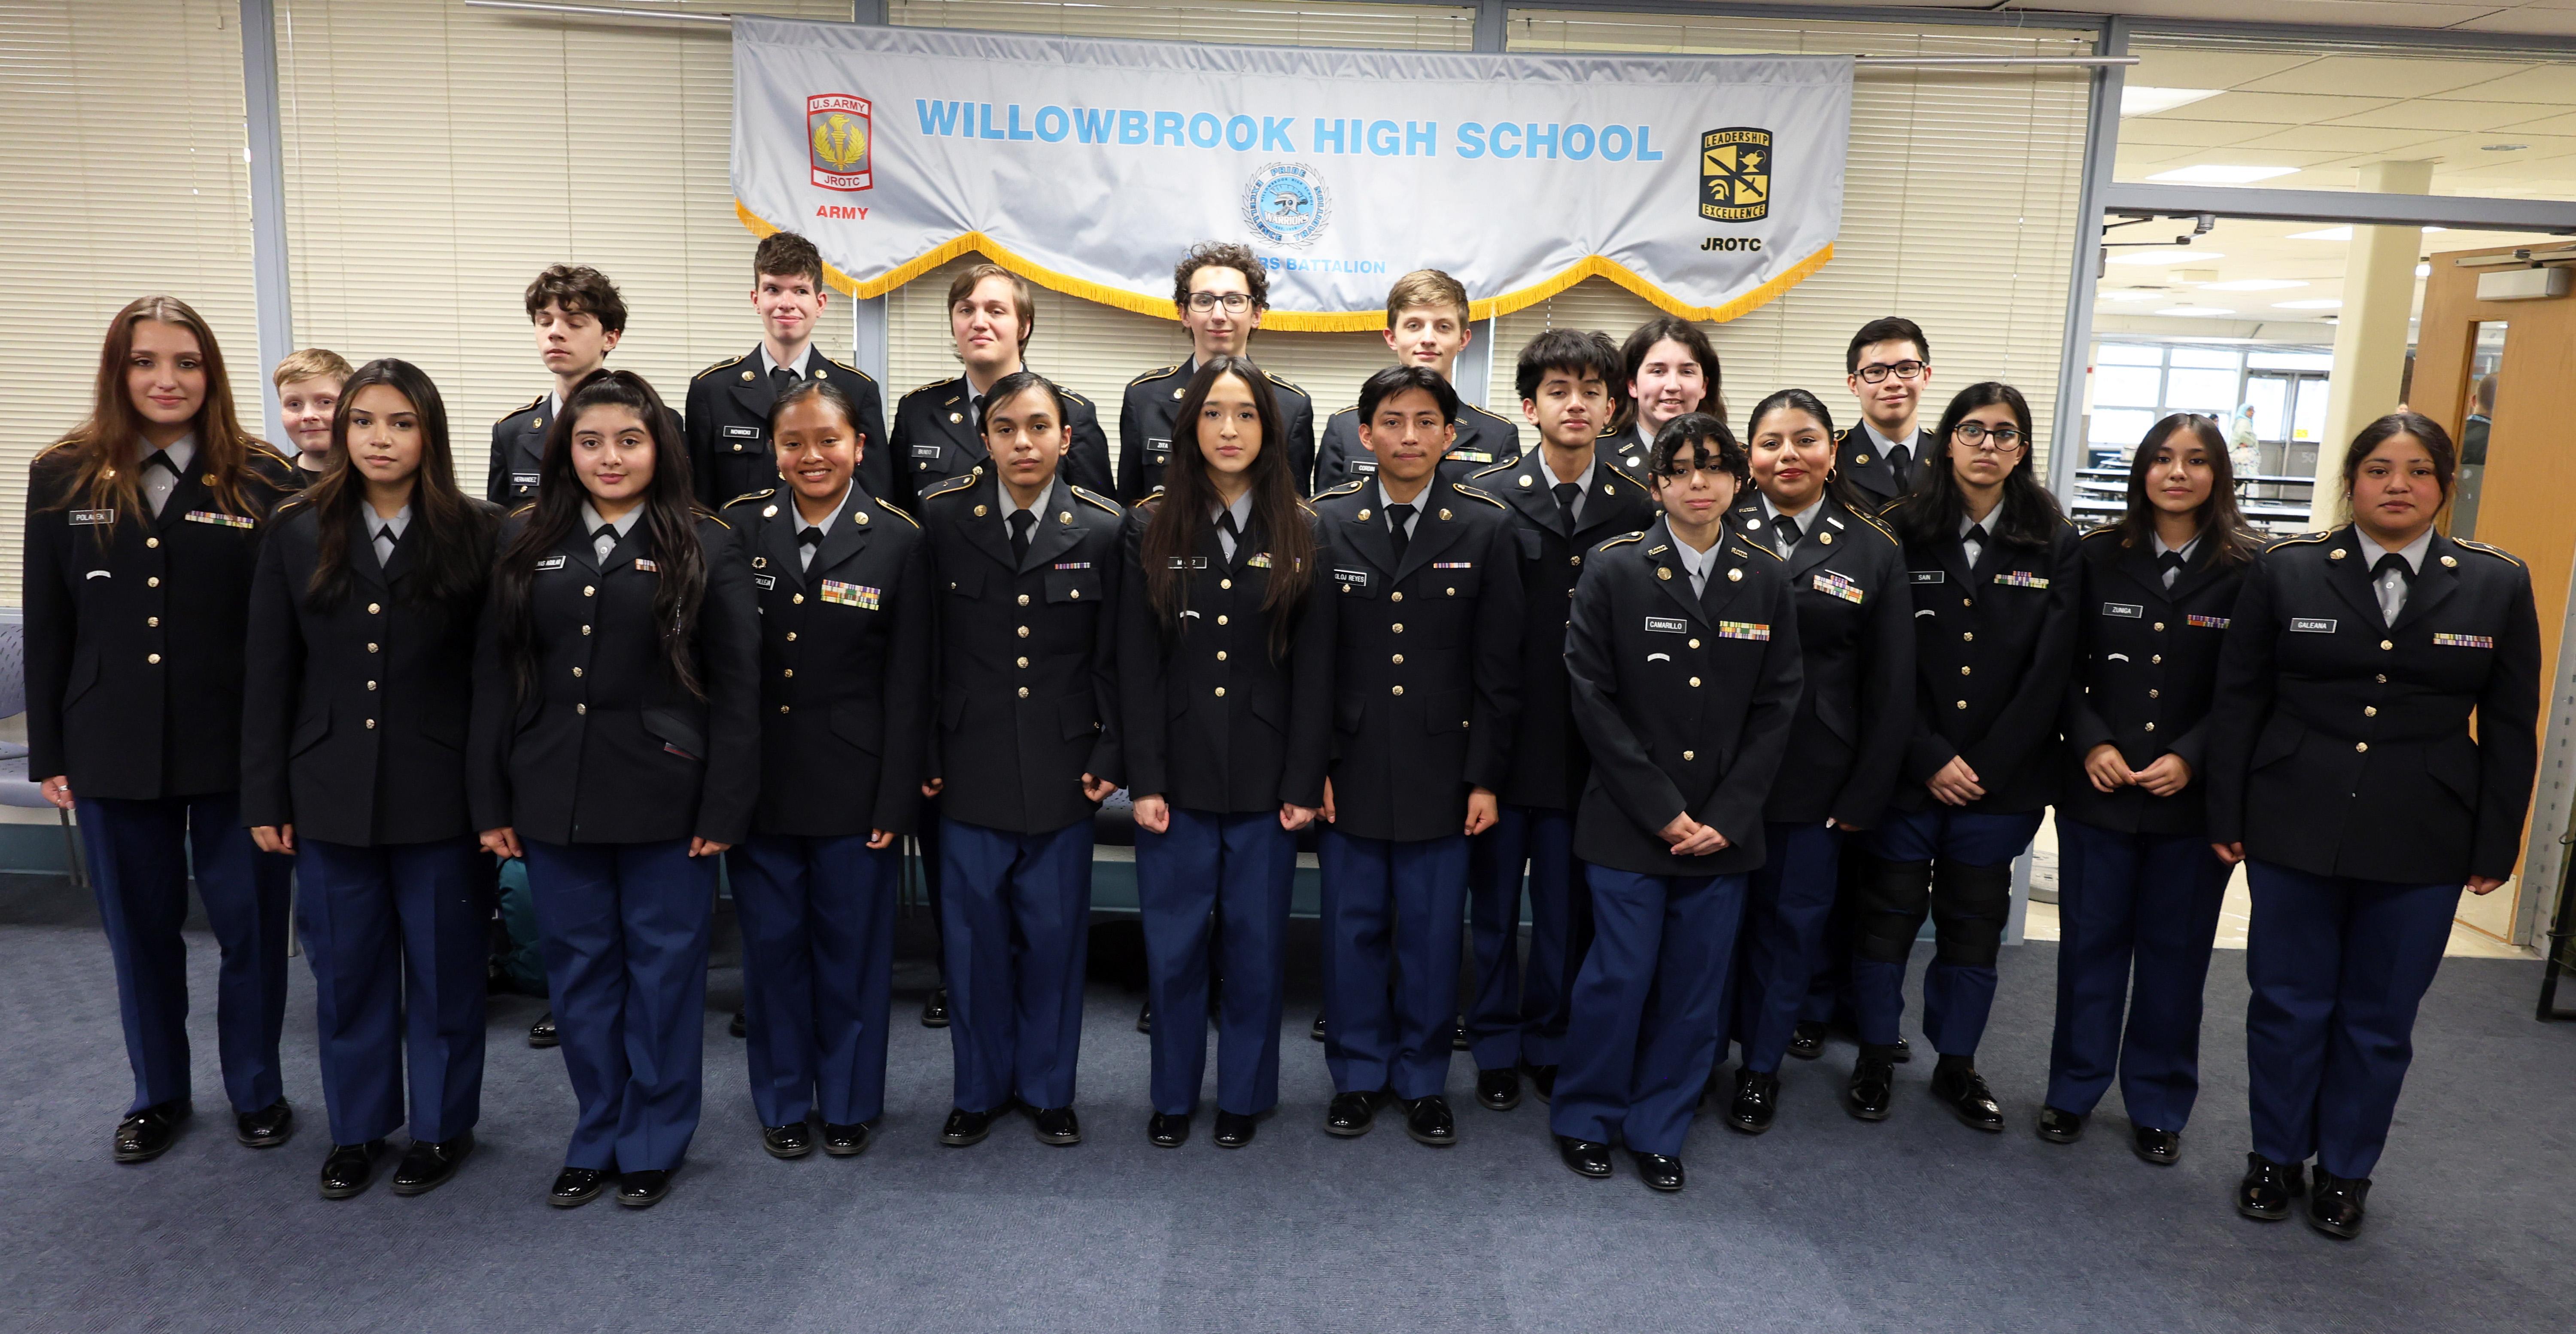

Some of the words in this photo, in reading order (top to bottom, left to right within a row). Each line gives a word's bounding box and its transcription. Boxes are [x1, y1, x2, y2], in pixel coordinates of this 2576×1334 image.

[915, 98, 1297, 153] WILLOWBROOK
[1313, 118, 1437, 157] HIGH
[1456, 122, 1664, 161] SCHOOL
[1706, 132, 1768, 147] LEADERSHIP
[1270, 166, 1306, 178] PRIDE
[824, 175, 860, 186] JROTC
[816, 205, 869, 220] ARMY
[1250, 179, 1282, 241] EXCELLENCE
[1264, 210, 1309, 225] WARRIORS
[1294, 186, 1324, 241] TRADITION
[1704, 205, 1764, 219] EXCELLENCE
[1701, 238, 1762, 251] JROTC
[1287, 258, 1385, 274] BATTALION
[1348, 575, 1364, 583] REYES
[1649, 621, 1683, 630] CAMARILLO
